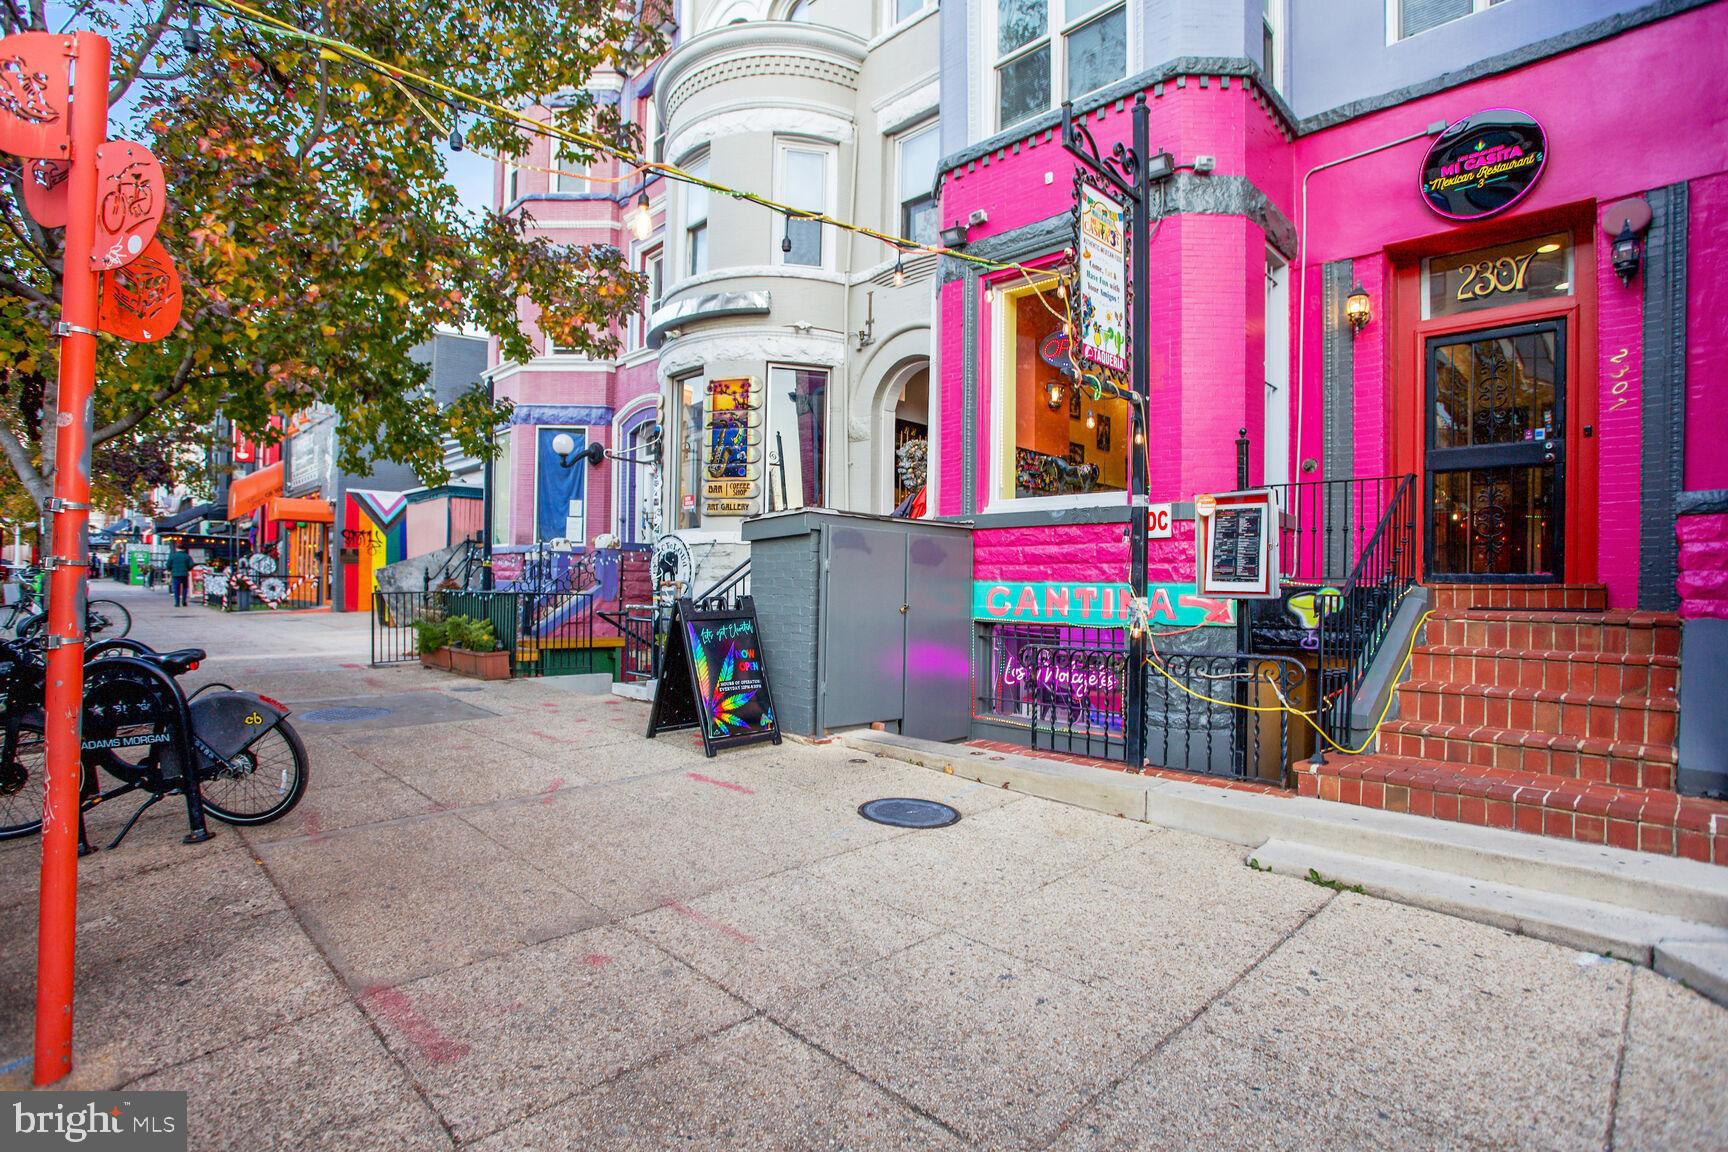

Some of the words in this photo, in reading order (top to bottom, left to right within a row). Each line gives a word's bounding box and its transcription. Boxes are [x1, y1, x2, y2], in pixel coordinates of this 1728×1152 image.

[1440, 163, 1460, 177] MI
[1464, 144, 1524, 170] CASITA
[1429, 171, 1474, 190] Mexican
[1476, 153, 1535, 178] Restaurant
[1457, 254, 1536, 300] 2307
[1093, 348, 1124, 370] TAQUERIA
[708, 485, 723, 494] BAR
[729, 482, 750, 490] COFFEE
[706, 503, 719, 511] ART
[720, 503, 750, 511] GALLERY
[736, 649, 755, 659] NOW
[739, 661, 759, 672] OPEN
[81, 738, 121, 750] ADAMS
[123, 733, 170, 746] MORGAN
